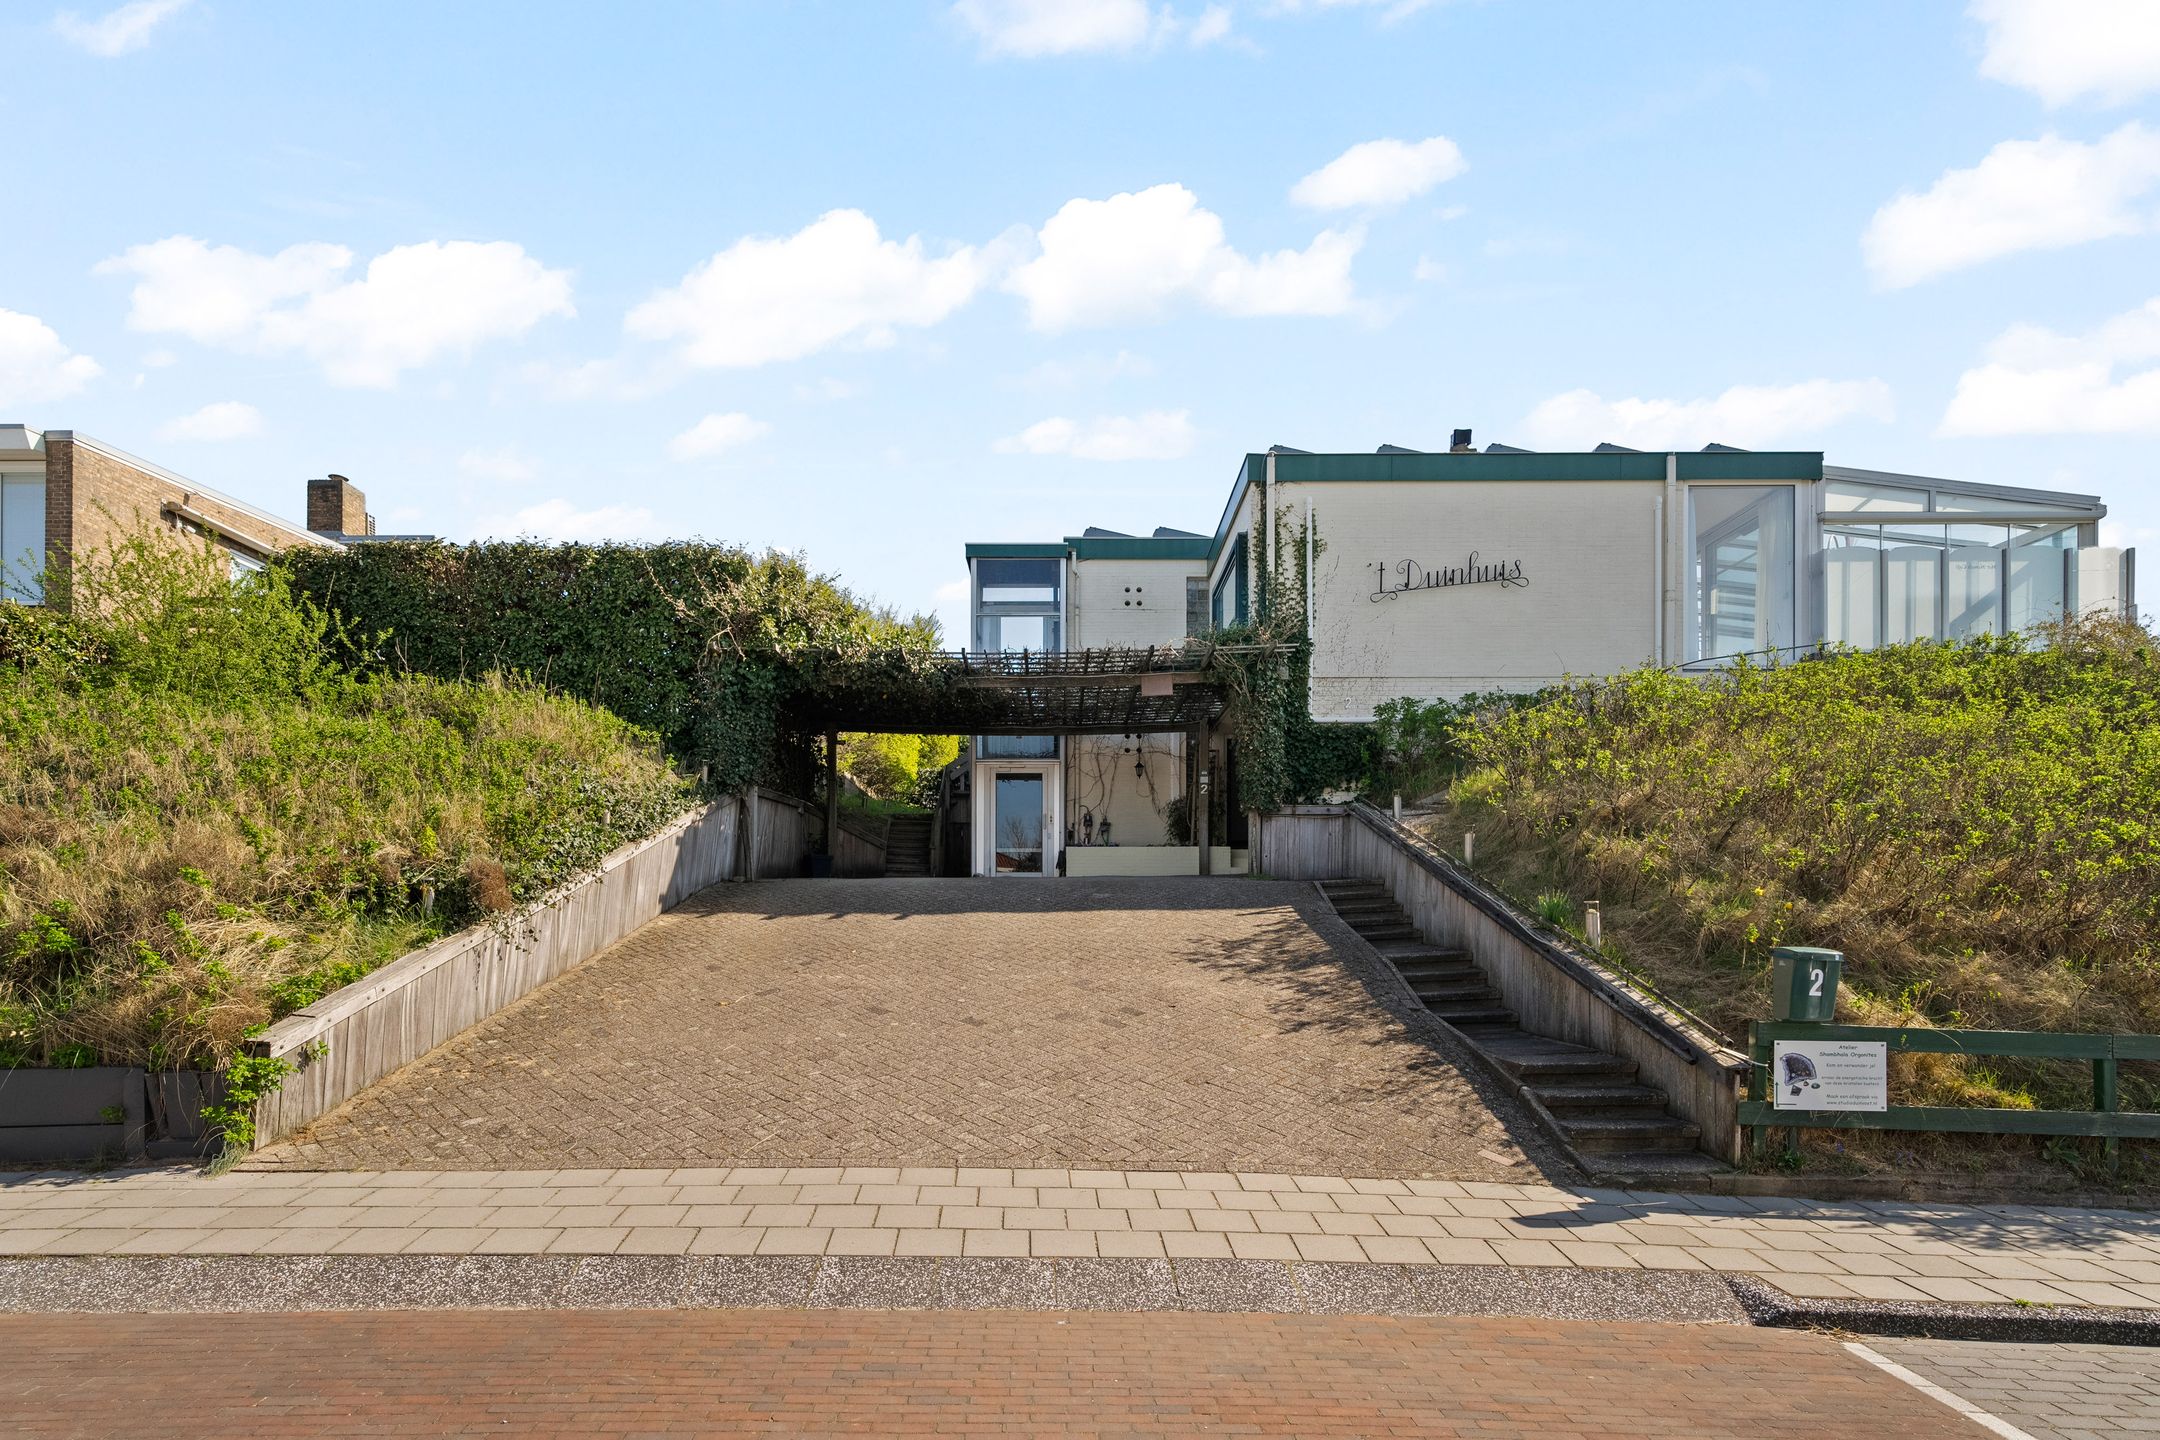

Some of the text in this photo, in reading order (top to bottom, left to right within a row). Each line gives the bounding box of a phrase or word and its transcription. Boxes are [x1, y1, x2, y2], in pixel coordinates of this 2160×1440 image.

[1395, 551, 1529, 592] Duinhuis
[1200, 784, 1208, 795] 2
[1808, 968, 1824, 997] 2
